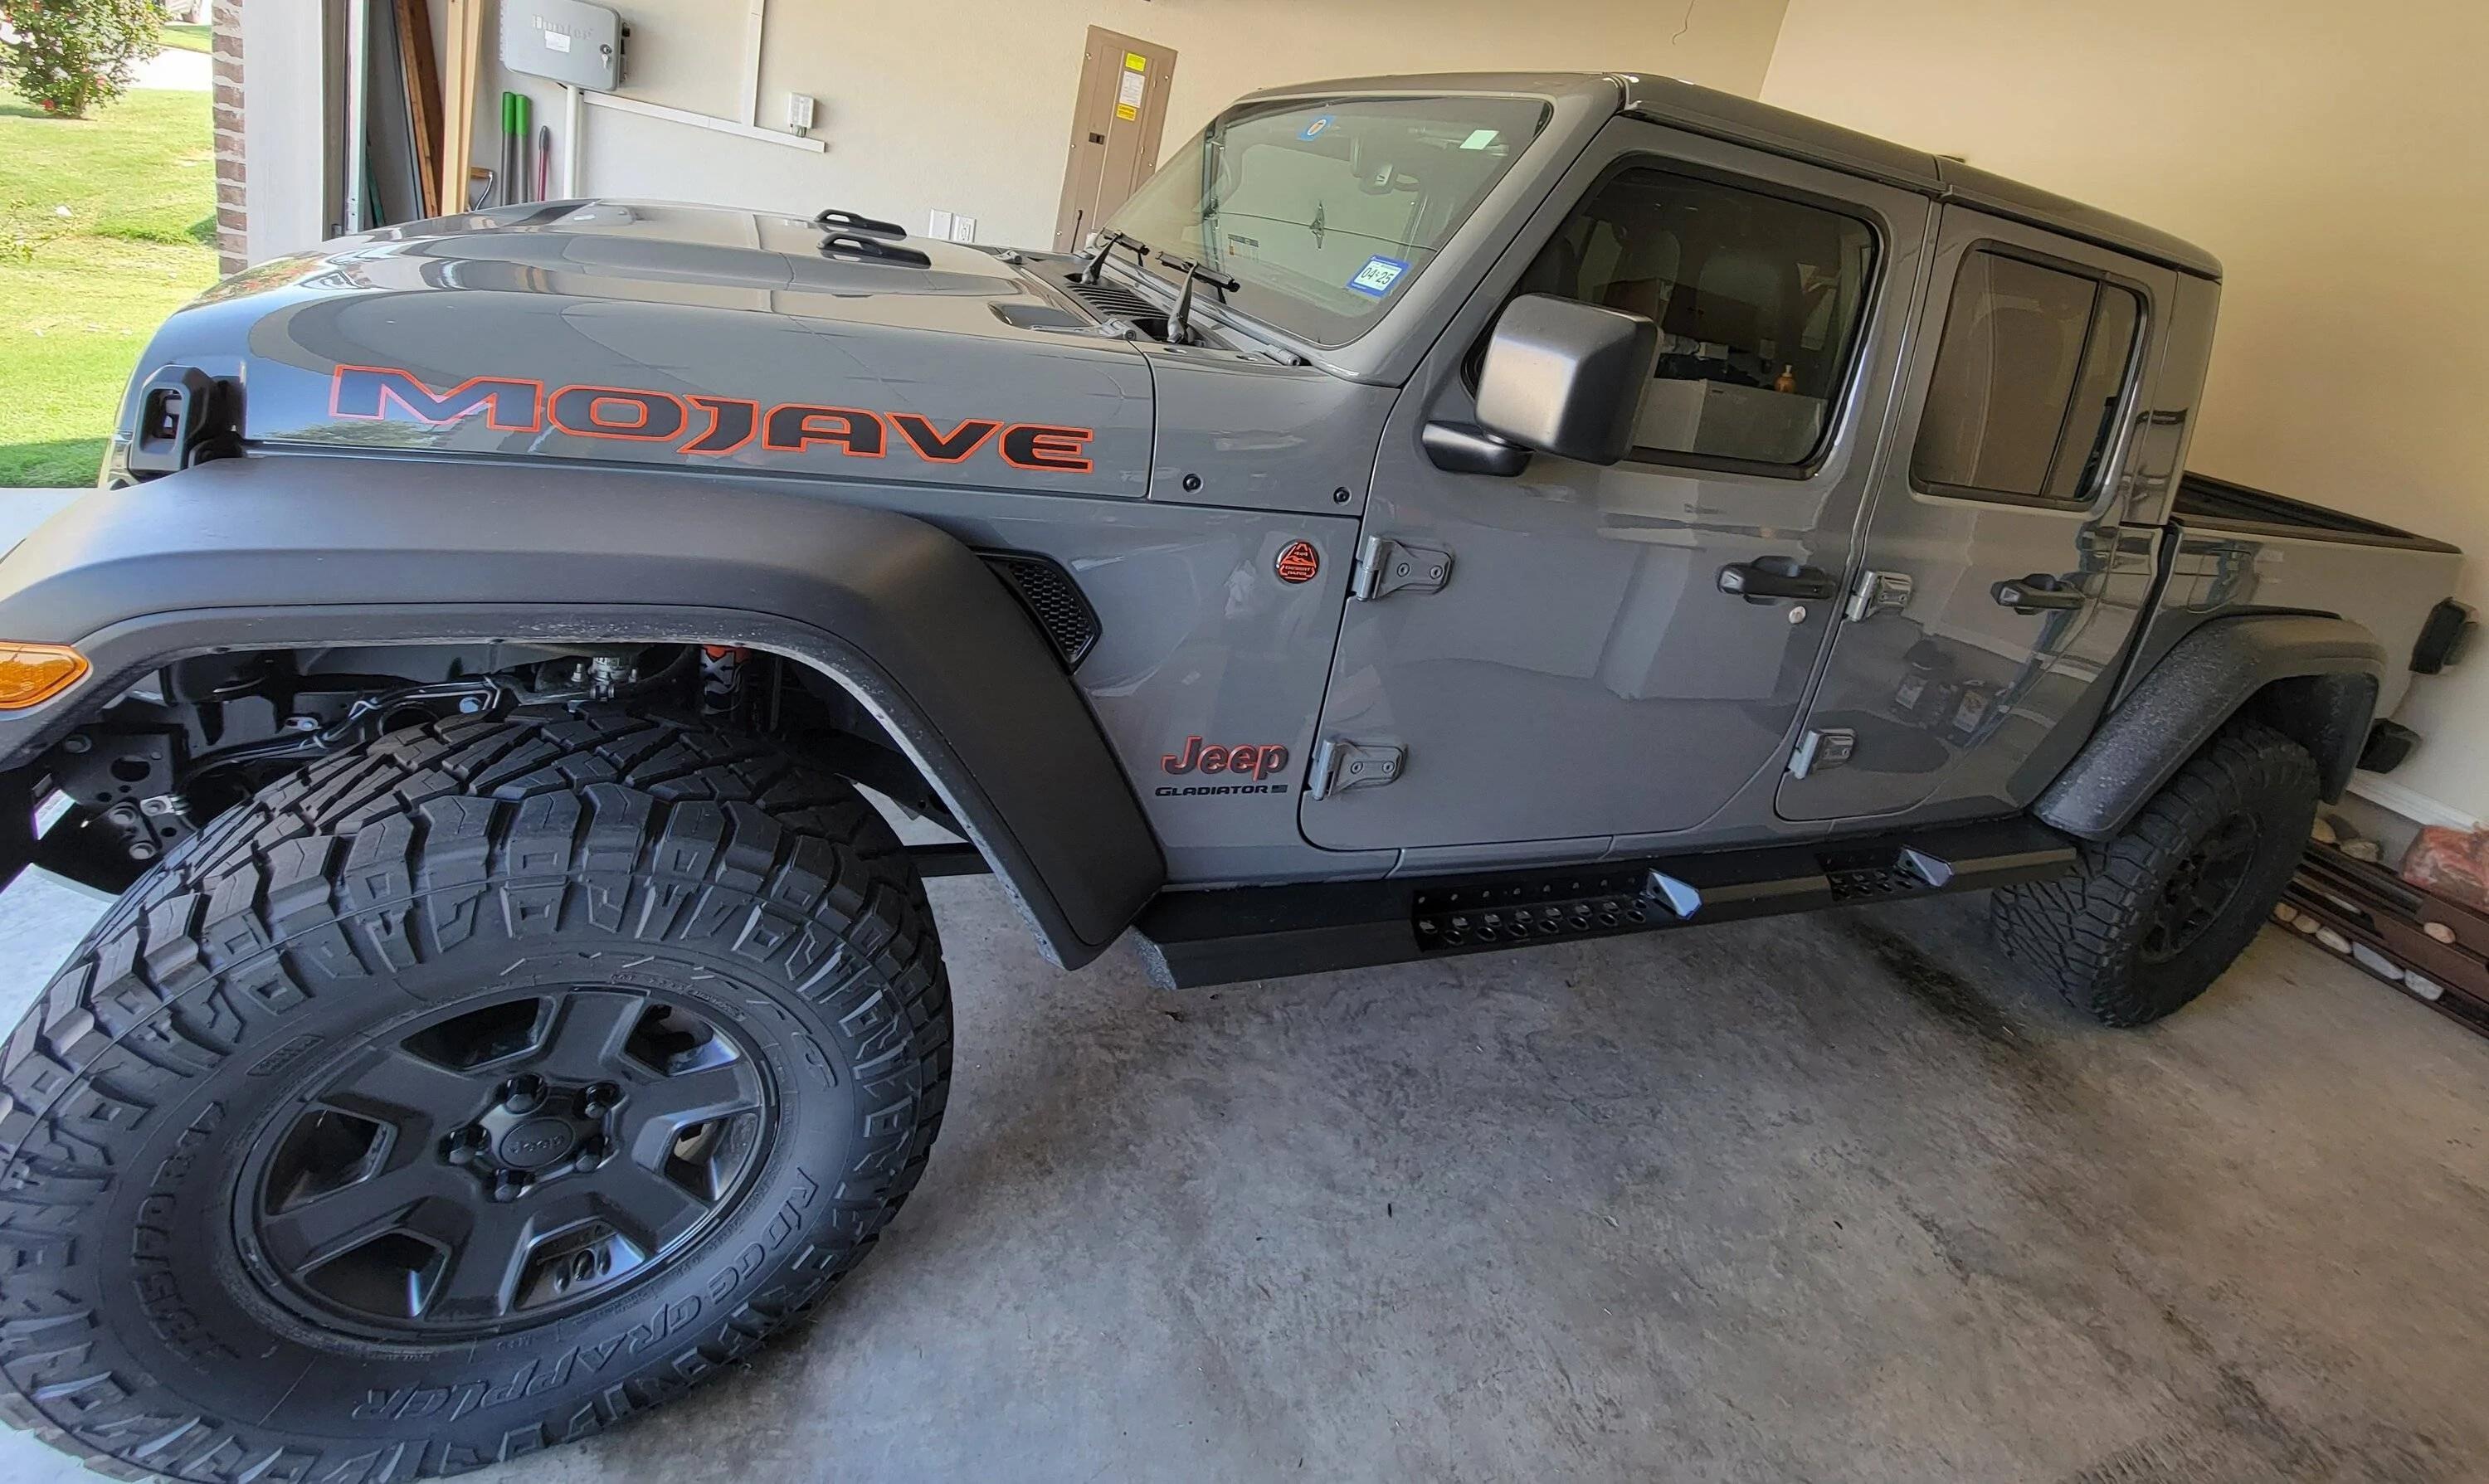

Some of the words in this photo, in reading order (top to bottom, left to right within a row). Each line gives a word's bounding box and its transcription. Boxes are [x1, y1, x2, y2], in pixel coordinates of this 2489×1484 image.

[329, 363, 1094, 474] MOJAVE
[1162, 736, 1289, 782] Jeep
[1155, 785, 1269, 796] GLADIATOR
